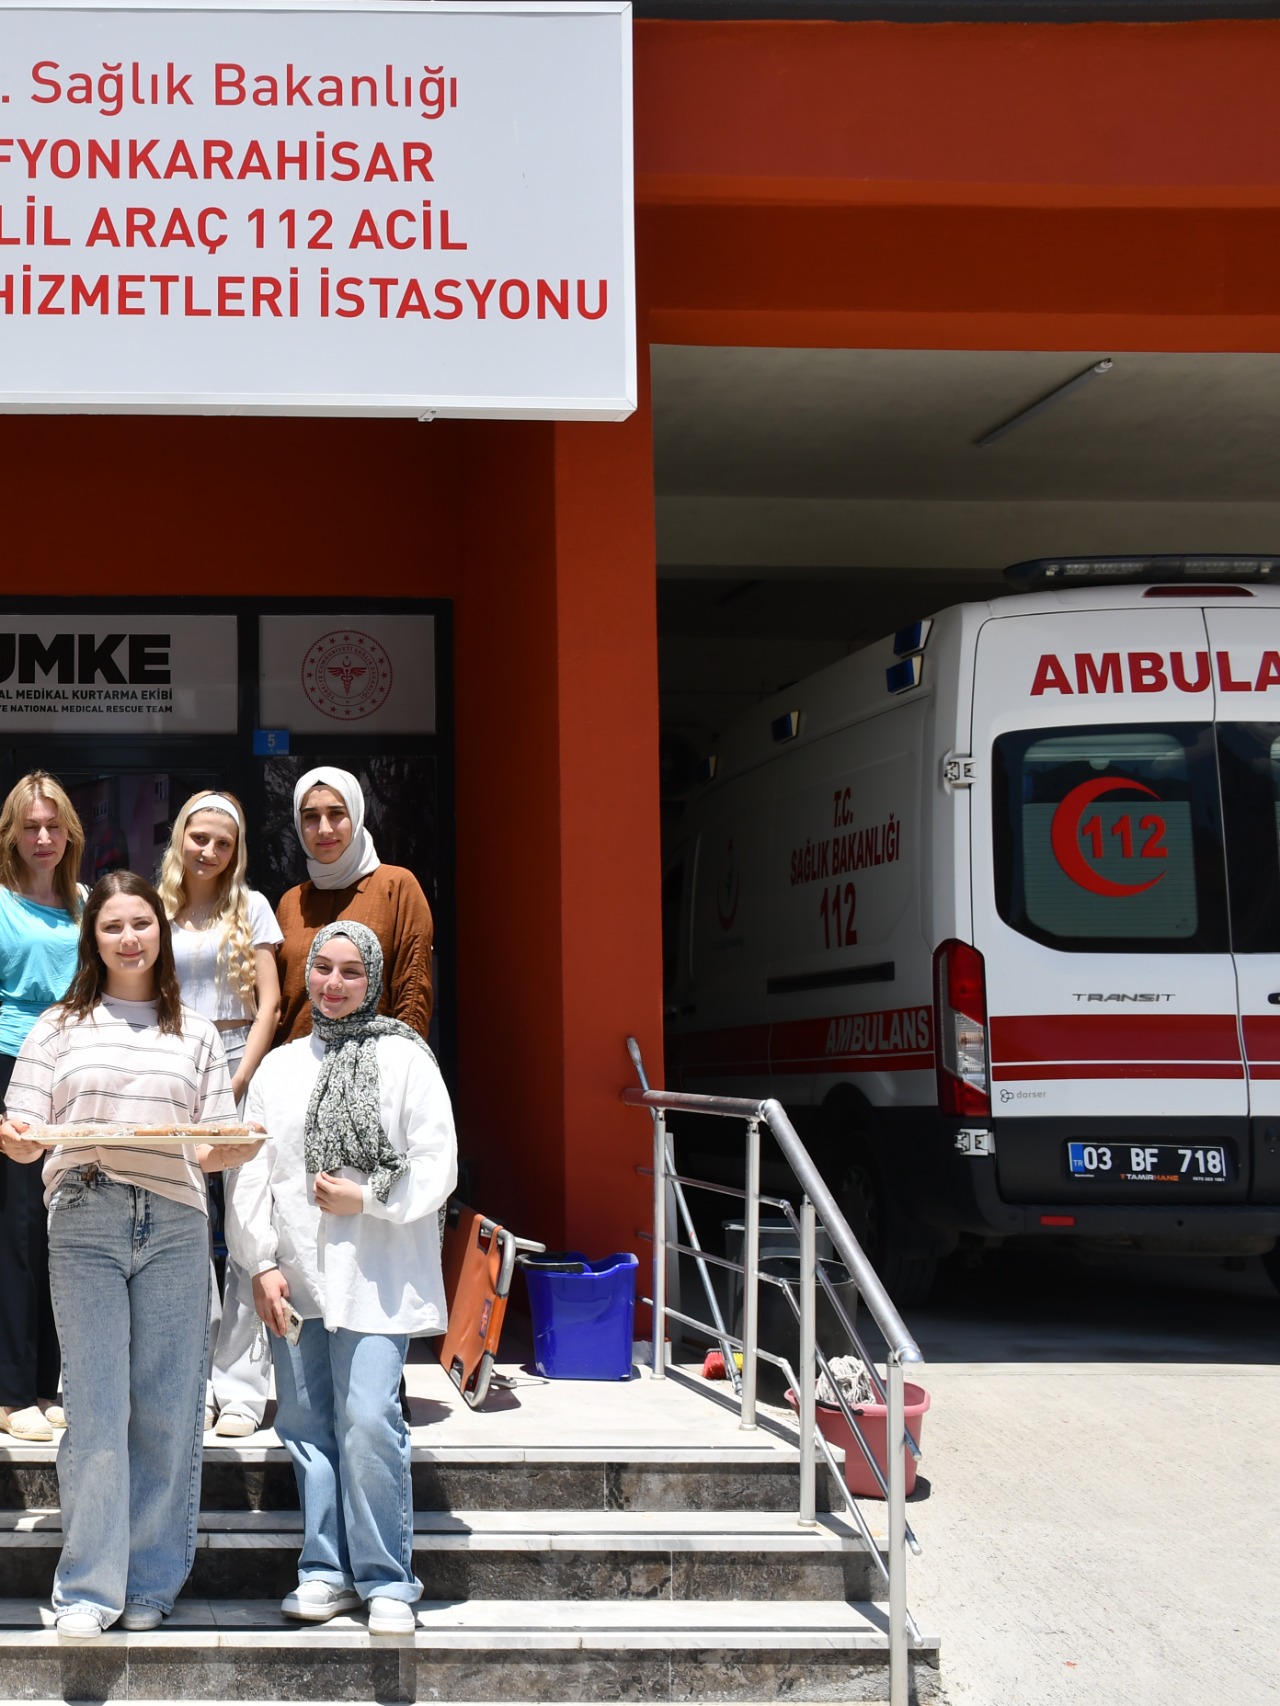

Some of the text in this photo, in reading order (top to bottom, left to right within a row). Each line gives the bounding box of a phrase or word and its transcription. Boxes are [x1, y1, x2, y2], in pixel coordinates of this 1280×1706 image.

[31, 60, 194, 116] Sağlık
[215, 63, 458, 119] Bakanlığı
[85, 207, 228, 254] ARAÇ
[247, 208, 333, 249] 112
[348, 200, 468, 250] ACİL
[319, 267, 608, 320] İSTASYONU
[10, 704, 59, 713] NATIONAL
[61, 705, 104, 713] MEDICAL
[107, 705, 144, 713] RESCUE
[146, 705, 173, 713] TEAM
[16, 687, 69, 700] MEDİKAL
[72, 689, 138, 700] KURTARMA
[141, 688, 173, 700] EKİBİ
[267, 733, 276, 748] 5
[833, 787, 854, 828] T.C.
[789, 812, 901, 886] SAĞLIK BAKANLIĞI
[1081, 814, 1169, 859] 112
[820, 881, 858, 950] 112
[1071, 993, 1177, 1003] TRANSIT
[824, 1008, 930, 1054] AMBULANS
[1073, 1146, 1223, 1174] TR 03 BF 718
